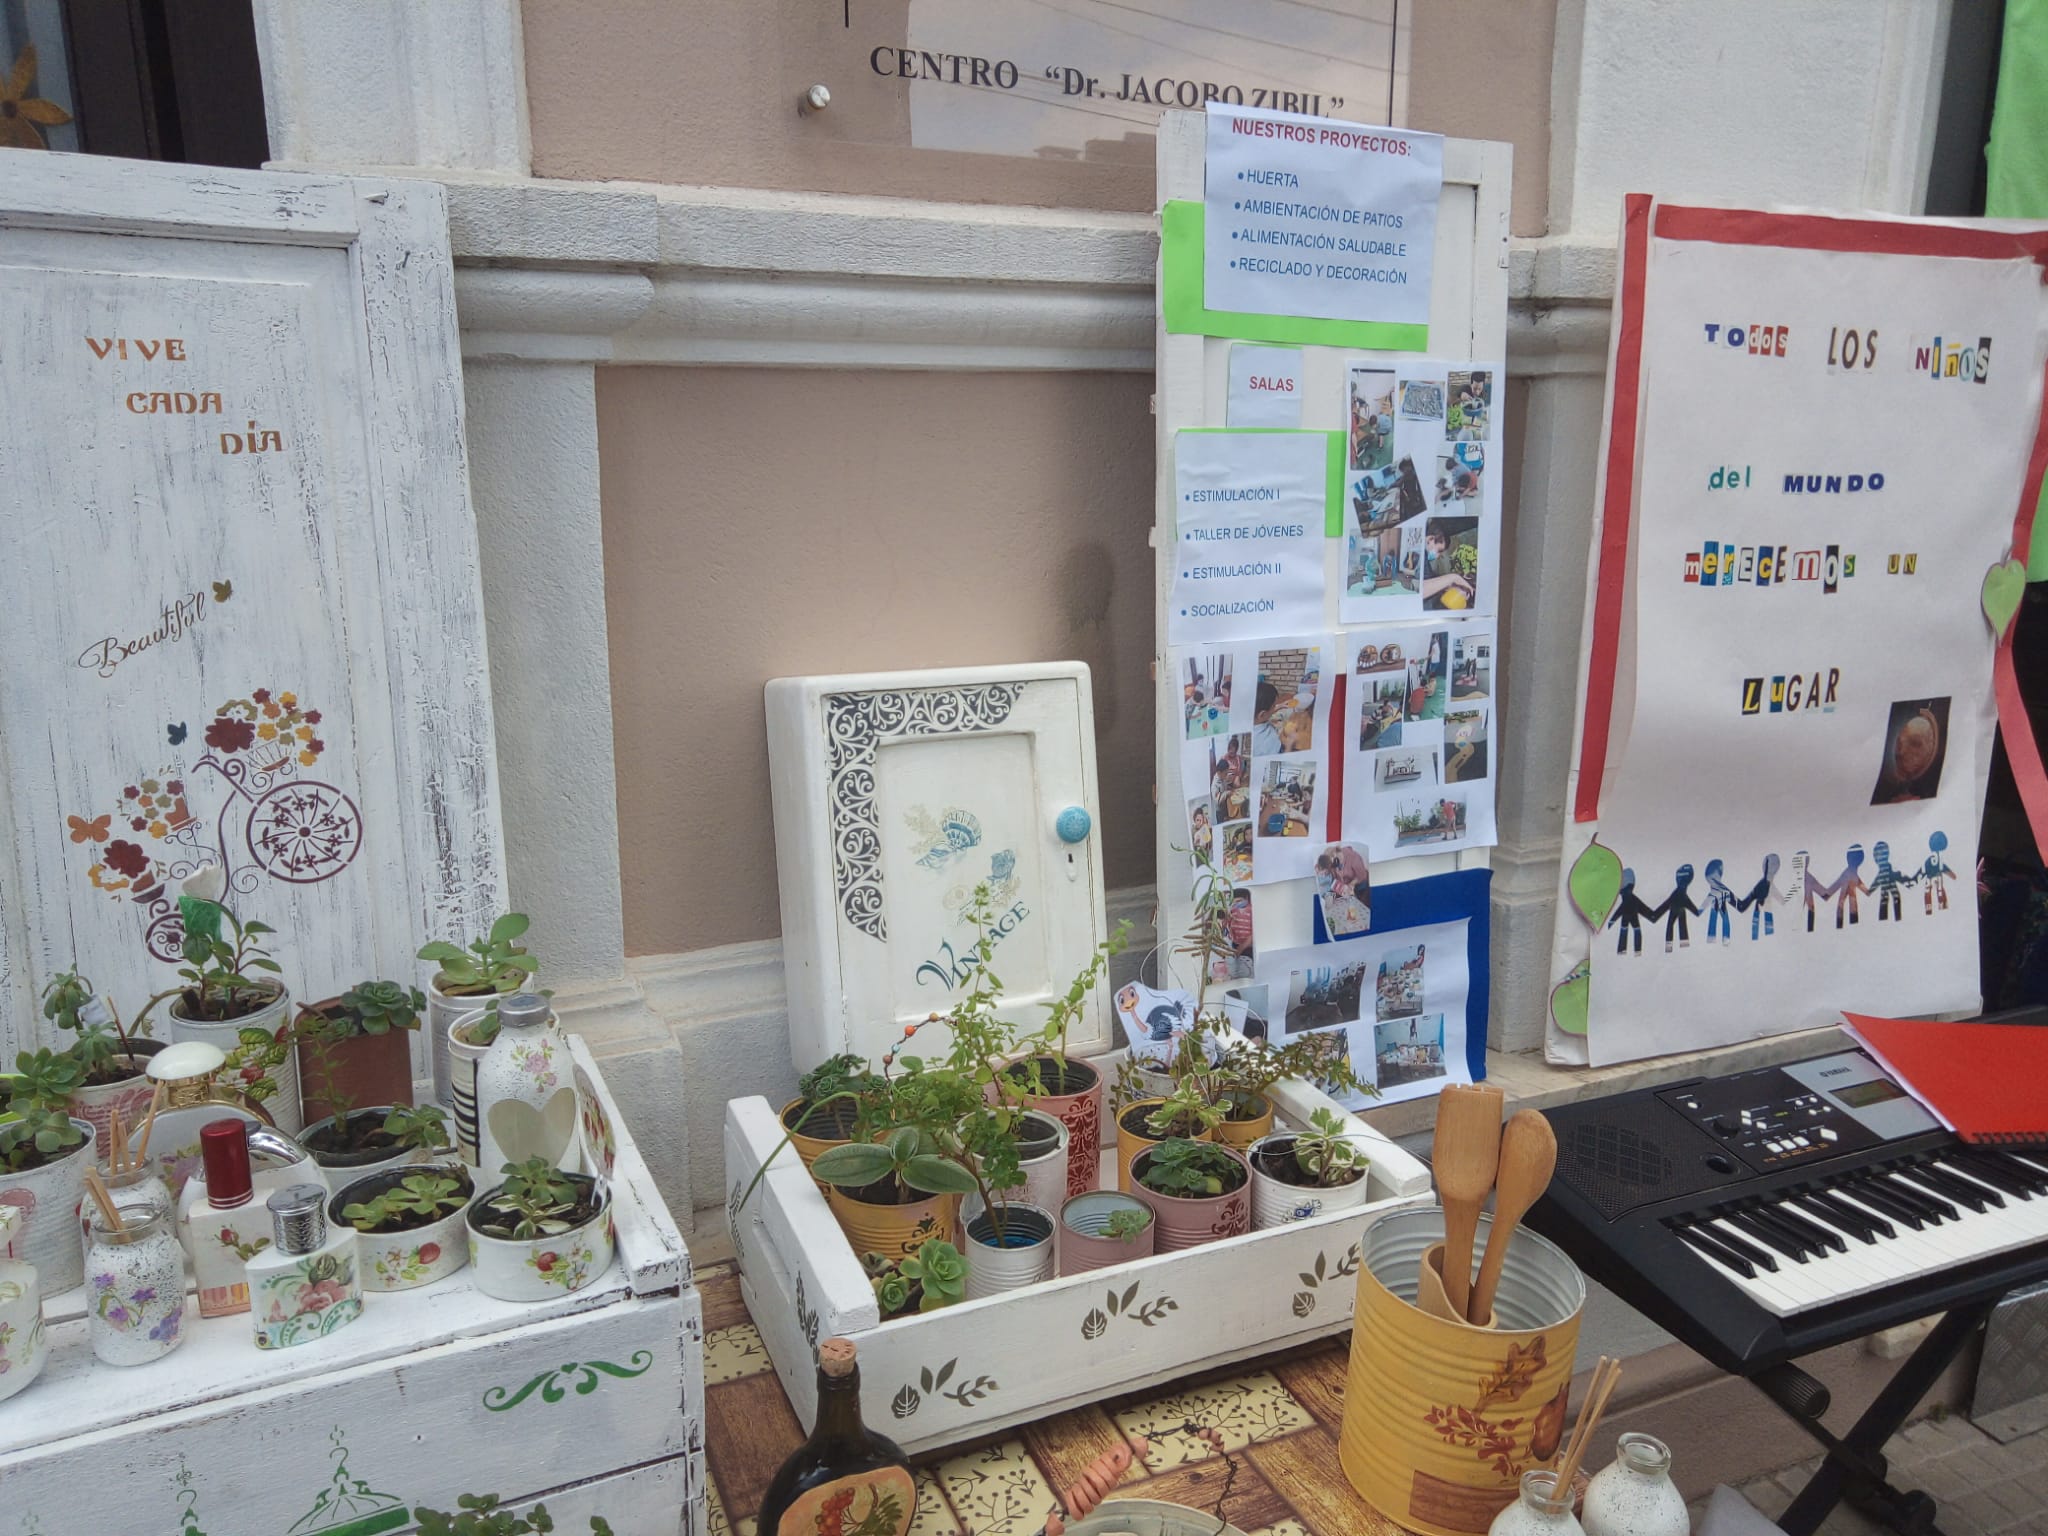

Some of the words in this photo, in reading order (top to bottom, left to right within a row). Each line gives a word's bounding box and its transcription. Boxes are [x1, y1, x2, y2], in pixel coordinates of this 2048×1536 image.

[869, 45, 1019, 90] CENTRO
[1232, 118, 1316, 143] NUESTROS
[1319, 130, 1412, 157] PROYECTOS:
[1246, 169, 1299, 188] HUERTA
[1243, 199, 1340, 222] AMBIENTACIÓN
[1342, 210, 1361, 224] DE
[1363, 212, 1404, 229] PATIOS
[1240, 228, 1336, 250] ALIMENTACIÓN
[1338, 238, 1408, 257] SALUDABLE
[1239, 257, 1313, 276] RECICLADO
[1316, 264, 1325, 277] Y
[1326, 265, 1408, 284] DECORACIÓN
[85, 336, 187, 361] VIVE
[1827, 326, 1879, 369] LOS
[1249, 375, 1295, 392] SALAS
[126, 391, 223, 415] CADA
[1709, 464, 1751, 489] del
[1784, 472, 1885, 494] MUNDO
[1192, 486, 1274, 502] ESTIMULACIÓN
[1193, 528, 1231, 541] TALLER
[1233, 527, 1250, 539] DE
[1251, 524, 1304, 538] JÓVENES
[1192, 561, 1272, 579] ESTIMULACIÓN
[1274, 562, 1281, 574] II
[1887, 553, 1918, 575] UN
[1190, 598, 1275, 617] SOCIALIZACIÓN
[78, 591, 207, 679] Beautiful
